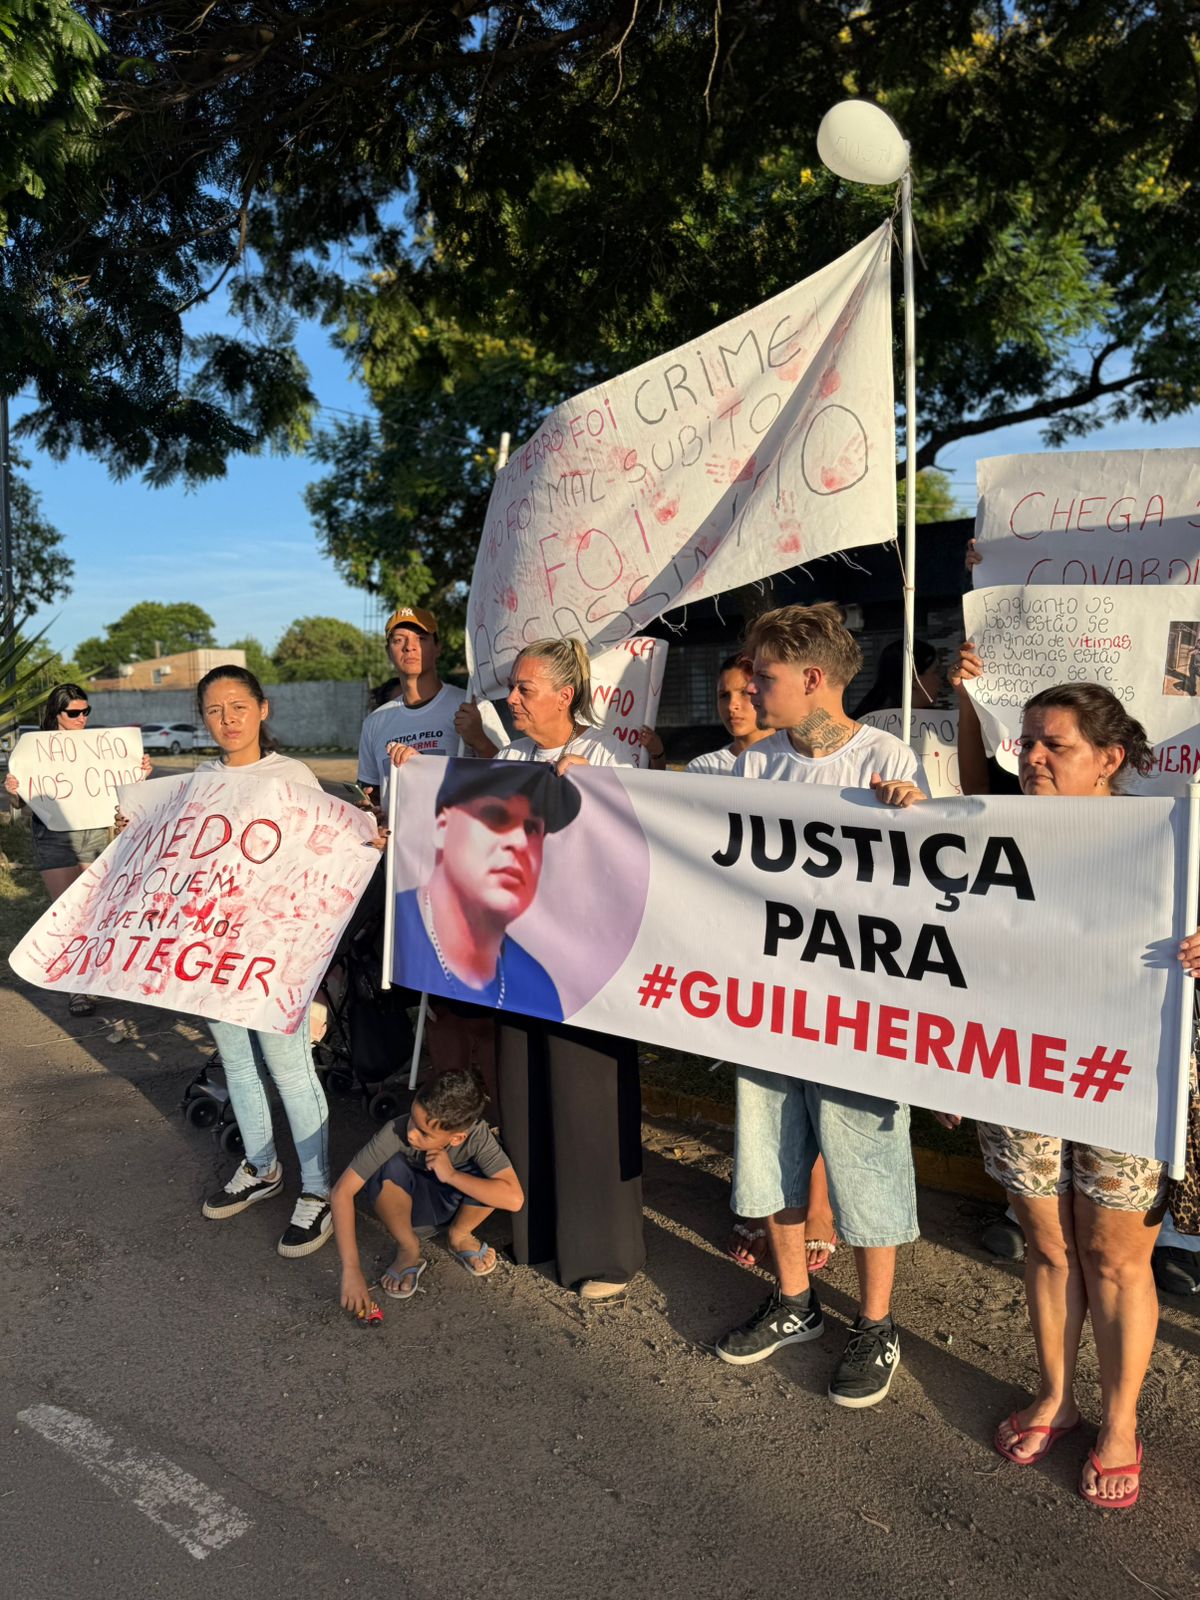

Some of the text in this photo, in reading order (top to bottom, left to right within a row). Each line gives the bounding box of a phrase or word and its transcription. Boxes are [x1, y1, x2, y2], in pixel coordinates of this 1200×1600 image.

[568, 398, 618, 449] FOI
[505, 480, 537, 541] FOI
[546, 467, 606, 513] MAL
[623, 392, 783, 484] SUBITO
[1009, 491, 1164, 541] CHEGA
[537, 502, 652, 607] FOI
[983, 592, 1115, 617] Enquanto os
[1026, 614, 1079, 634] estão
[1088, 617, 1109, 633] se
[977, 644, 1121, 665] as ovelhas estão
[1047, 634, 1065, 648] de
[1068, 633, 1133, 652] vítimas,
[981, 661, 1057, 678] tentando
[1067, 665, 1088, 681] se
[36, 730, 128, 763] NÃO VÃO
[419, 730, 443, 740] PELO
[28, 772, 74, 802] NOS
[124, 813, 282, 867] MEDO
[711, 811, 1036, 912] JUSTIÇA
[107, 866, 237, 909] DE QUEM
[45, 935, 278, 998] PROTEGER
[763, 899, 969, 990] PARA
[636, 962, 1133, 1104] #GUILHERME#
